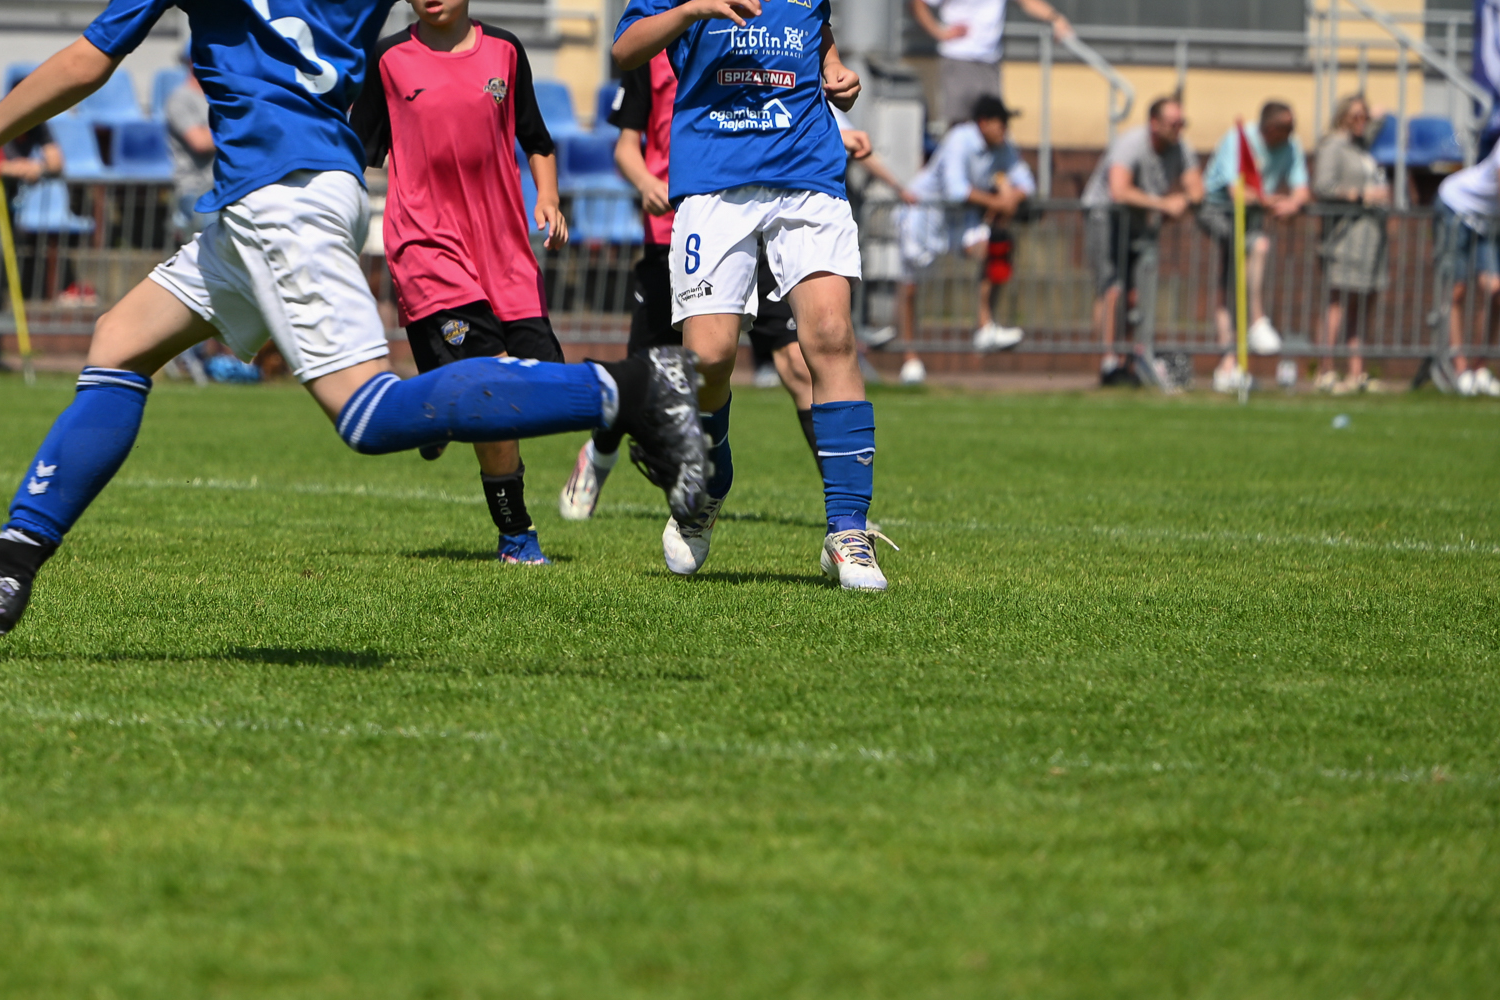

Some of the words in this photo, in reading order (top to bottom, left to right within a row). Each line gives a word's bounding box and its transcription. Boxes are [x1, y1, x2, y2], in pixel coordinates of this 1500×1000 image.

[724, 70, 792, 86] SPIŻARNIA
[709, 107, 771, 121] ogarniam
[719, 119, 774, 131] najem.pl
